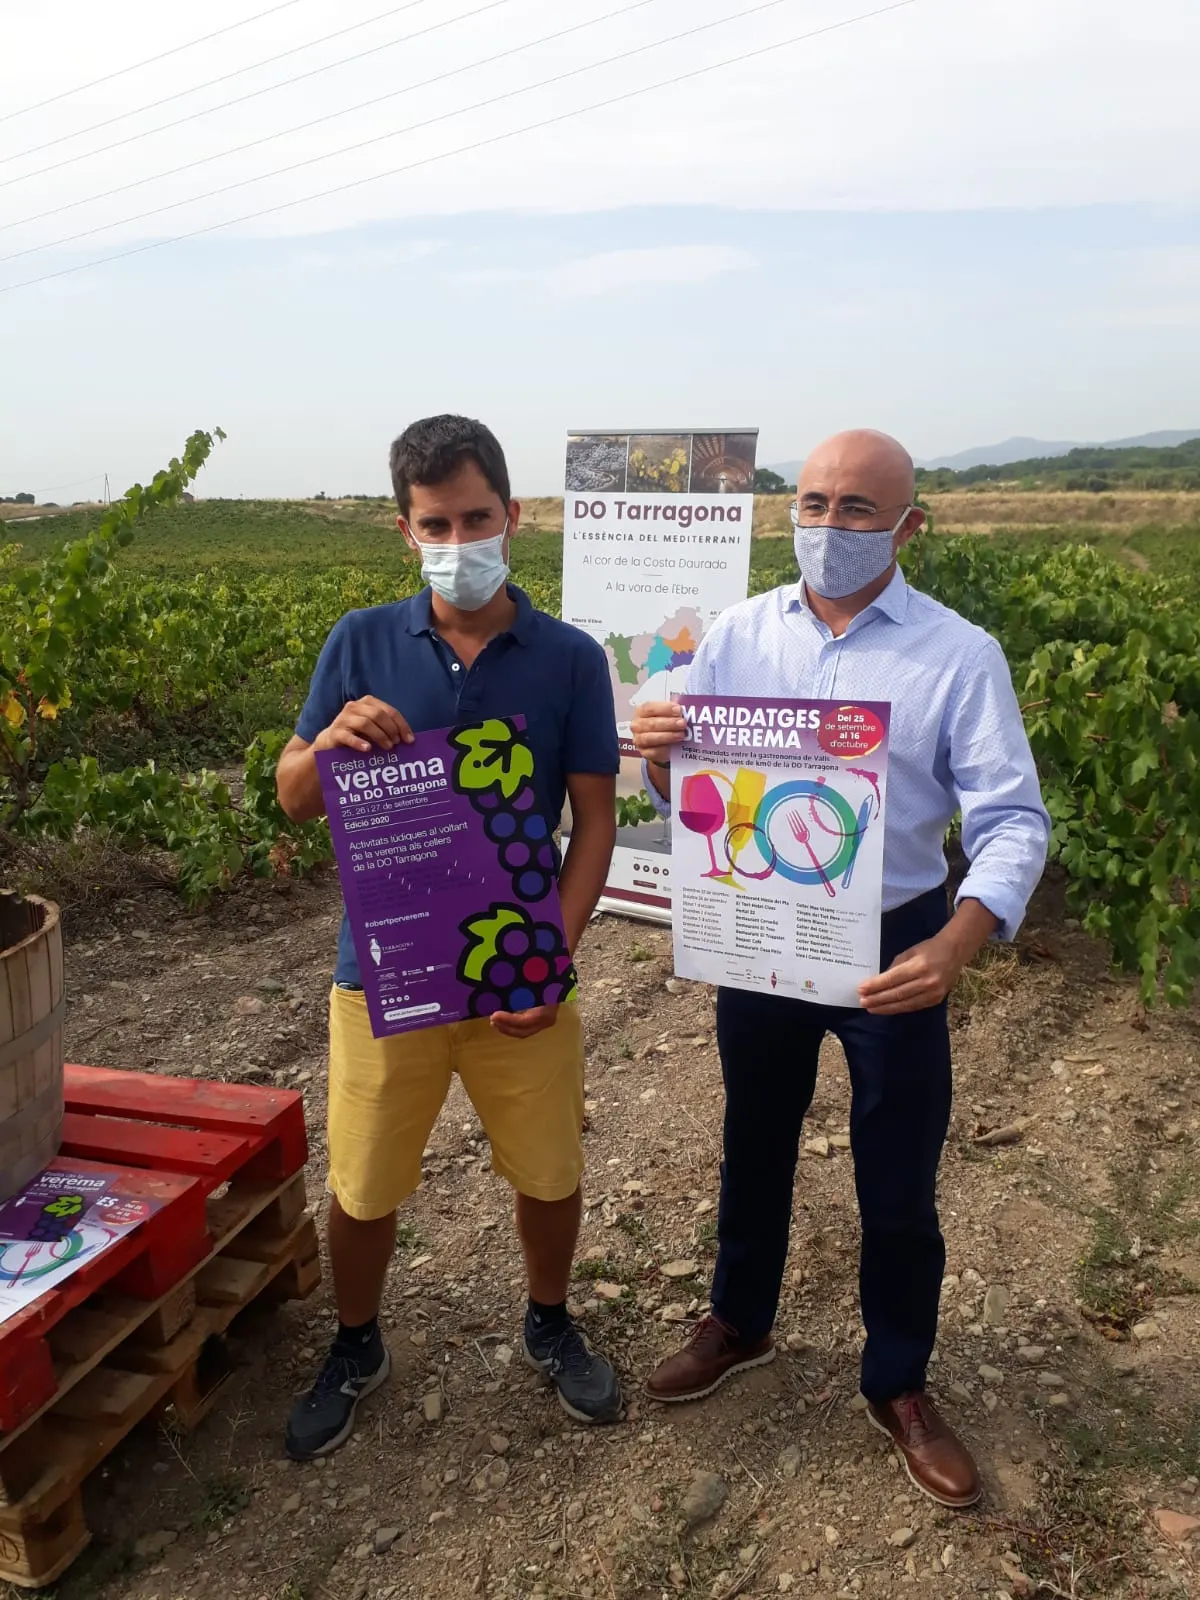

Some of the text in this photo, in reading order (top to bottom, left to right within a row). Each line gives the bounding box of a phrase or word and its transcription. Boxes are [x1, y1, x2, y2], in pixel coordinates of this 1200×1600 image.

[574, 501, 741, 528] DO Tarragona
[573, 530, 741, 544] L'ESSÈNCIA DEL MEDITERRANI
[583, 555, 727, 570] Al cor de la Costa Daurada
[606, 581, 699, 595] A la vora de l'Ebre
[682, 705, 820, 730] MARIDATGES
[837, 714, 864, 723] Del 25
[837, 723, 876, 732] setembre
[711, 727, 801, 749] VEREMA
[830, 740, 868, 749] d'octubre
[331, 753, 398, 773] Festa de la
[773, 760, 782, 768] de
[804, 763, 839, 771] Tarragona
[334, 757, 445, 792] verema
[339, 778, 447, 805] a la DO Tarragona
[383, 801, 392, 809] de
[395, 796, 428, 808] setembre
[345, 816, 390, 830] Edició 2020
[350, 822, 468, 850] Activitats lúdiques al voltant
[352, 836, 452, 861] de la verema als cellers
[353, 864, 364, 872] de
[377, 858, 391, 867] DO
[395, 851, 438, 864] Tarragona
[40, 1176, 105, 1186] verema
